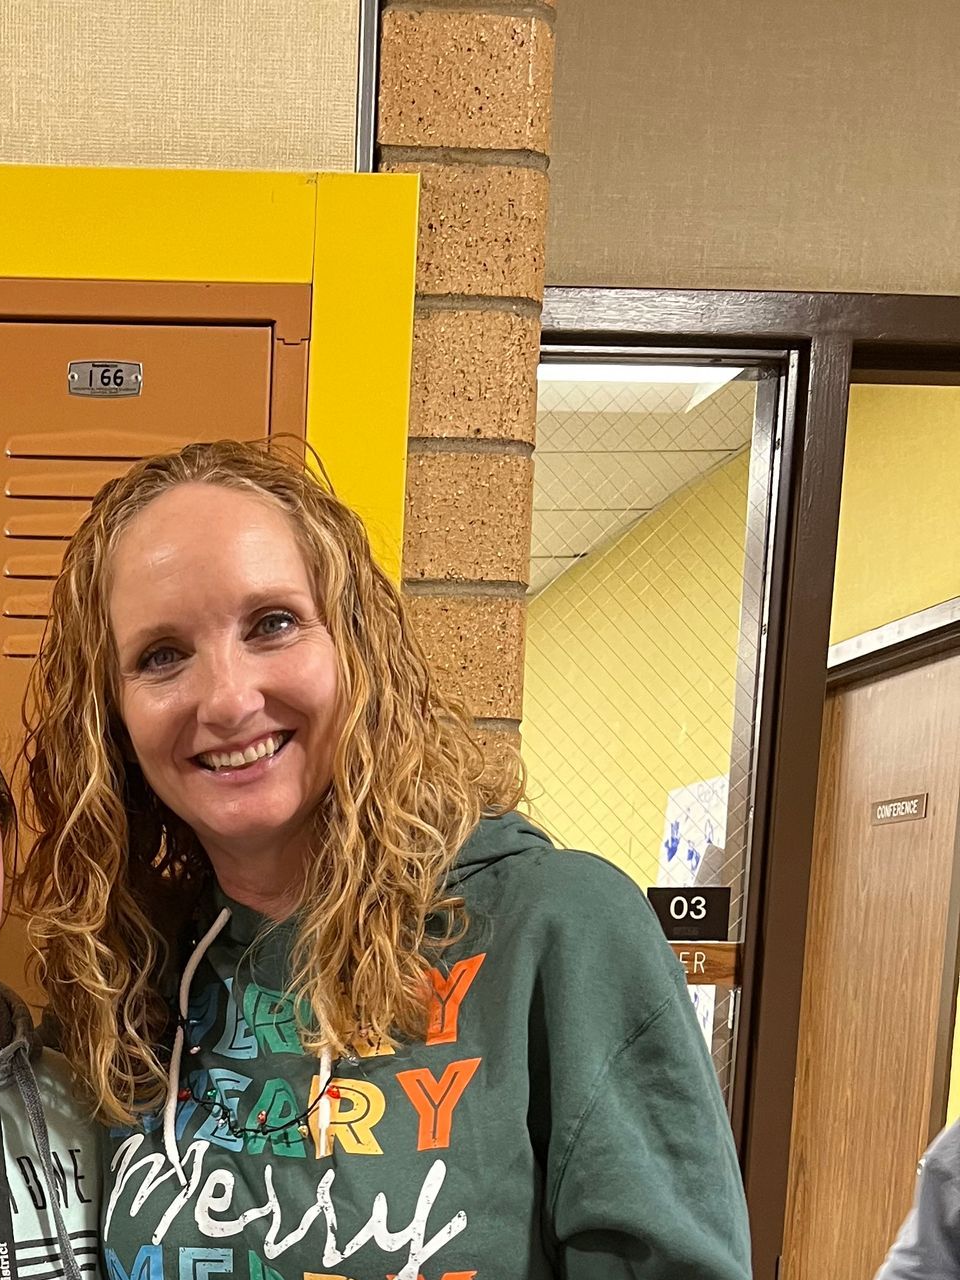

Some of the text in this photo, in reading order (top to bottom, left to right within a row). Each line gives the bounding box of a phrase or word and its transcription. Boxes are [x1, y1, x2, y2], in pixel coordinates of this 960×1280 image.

[89, 369, 123, 387] 166
[877, 799, 918, 819] CONFERENCE
[670, 896, 707, 920] 03
